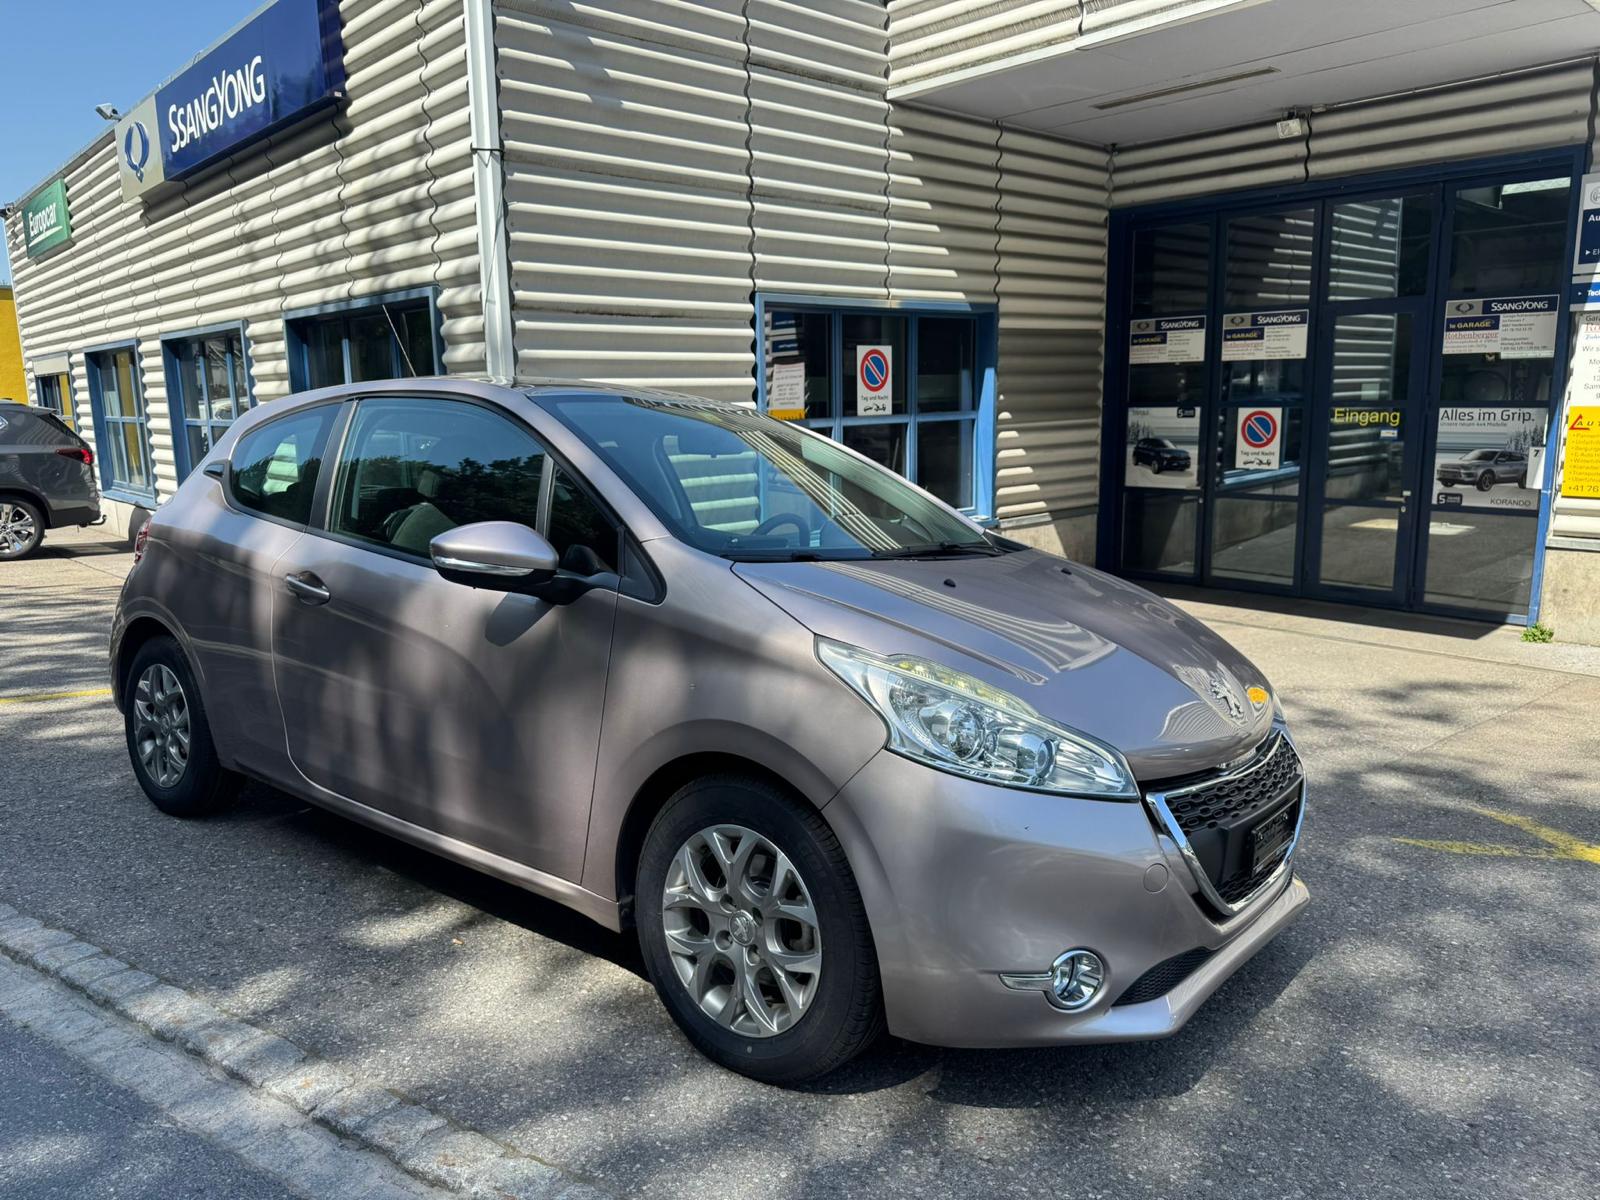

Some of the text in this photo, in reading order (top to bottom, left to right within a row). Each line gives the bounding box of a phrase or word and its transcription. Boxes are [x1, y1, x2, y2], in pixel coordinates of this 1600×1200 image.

[28, 202, 57, 237] Europcar
[1456, 320, 1492, 329] GARAGE
[1231, 330, 1258, 339] GARAGE
[1334, 408, 1400, 427] Eingang
[1440, 409, 1535, 424] Alles im Grip.
[1533, 449, 1540, 458] 7
[1490, 497, 1531, 507] KORANDO
